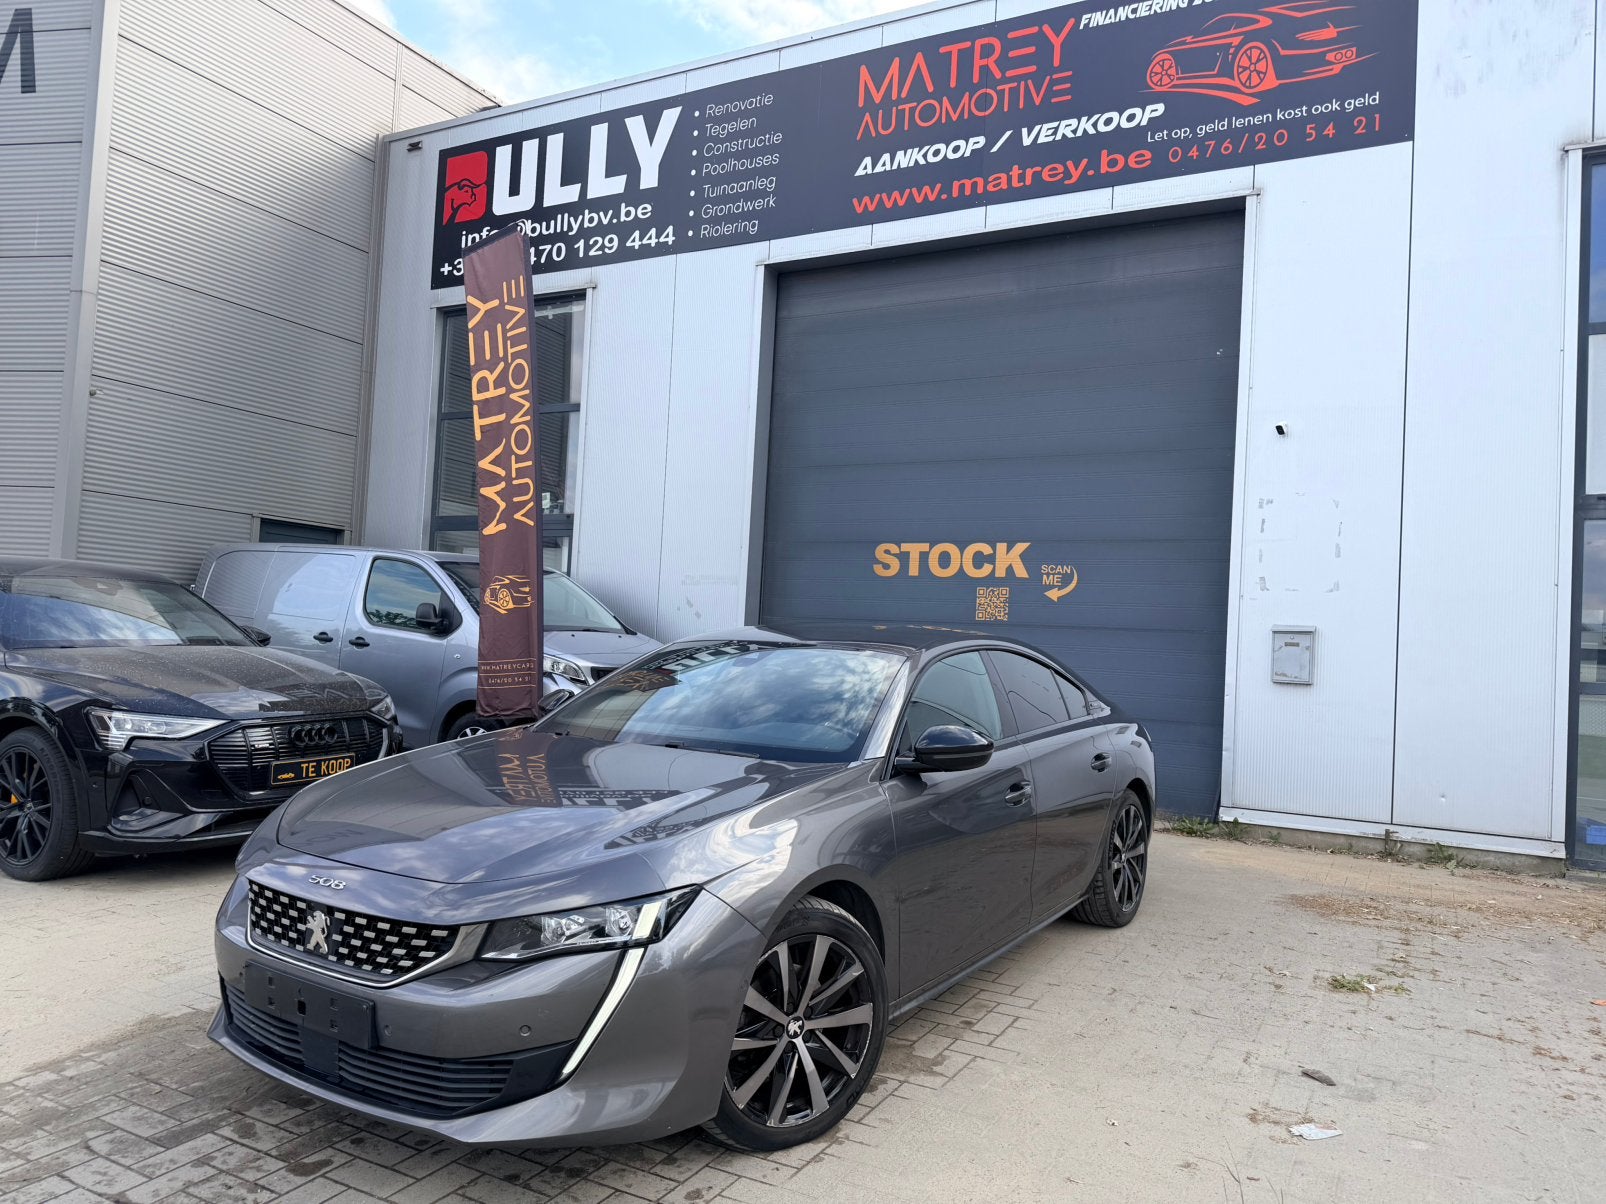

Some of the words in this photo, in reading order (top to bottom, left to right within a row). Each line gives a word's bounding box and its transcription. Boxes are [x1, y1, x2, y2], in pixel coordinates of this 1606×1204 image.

[858, 18, 1075, 108] MATREY
[706, 93, 774, 118] Renovatie
[856, 71, 1073, 141] AUTOMOTIVE
[1148, 128, 1167, 142] Let
[1171, 126, 1193, 141] op,
[1197, 116, 1228, 137] geld
[1232, 112, 1272, 129] lenen
[1277, 104, 1307, 120] kost
[1312, 99, 1340, 114] ook
[1345, 92, 1379, 112] geld
[705, 117, 757, 138] Tegelen
[854, 136, 986, 177] AANKOOP
[1021, 103, 1165, 147] VERKOOP
[1168, 129, 1288, 162] 0476/20
[1306, 122, 1335, 141] 54
[1353, 114, 1380, 134] 21
[703, 131, 783, 157] Constructie
[702, 153, 780, 177] Poolhouses
[702, 176, 776, 198] Tuinaanleg
[853, 149, 1152, 214] www.matrey.be
[701, 194, 776, 218] Grondwerk
[574, 233, 619, 258] 129
[626, 225, 676, 248] 444
[700, 220, 759, 239] Riolering
[503, 274, 535, 526] AUTOMOTIVE
[467, 295, 507, 536] MATREY
[873, 543, 1031, 578] STOCK
[1041, 565, 1071, 574] SCAN
[1042, 575, 1062, 585] ME
[301, 763, 317, 778] TE
[321, 759, 351, 776] KOOP
[309, 874, 346, 890] 508
